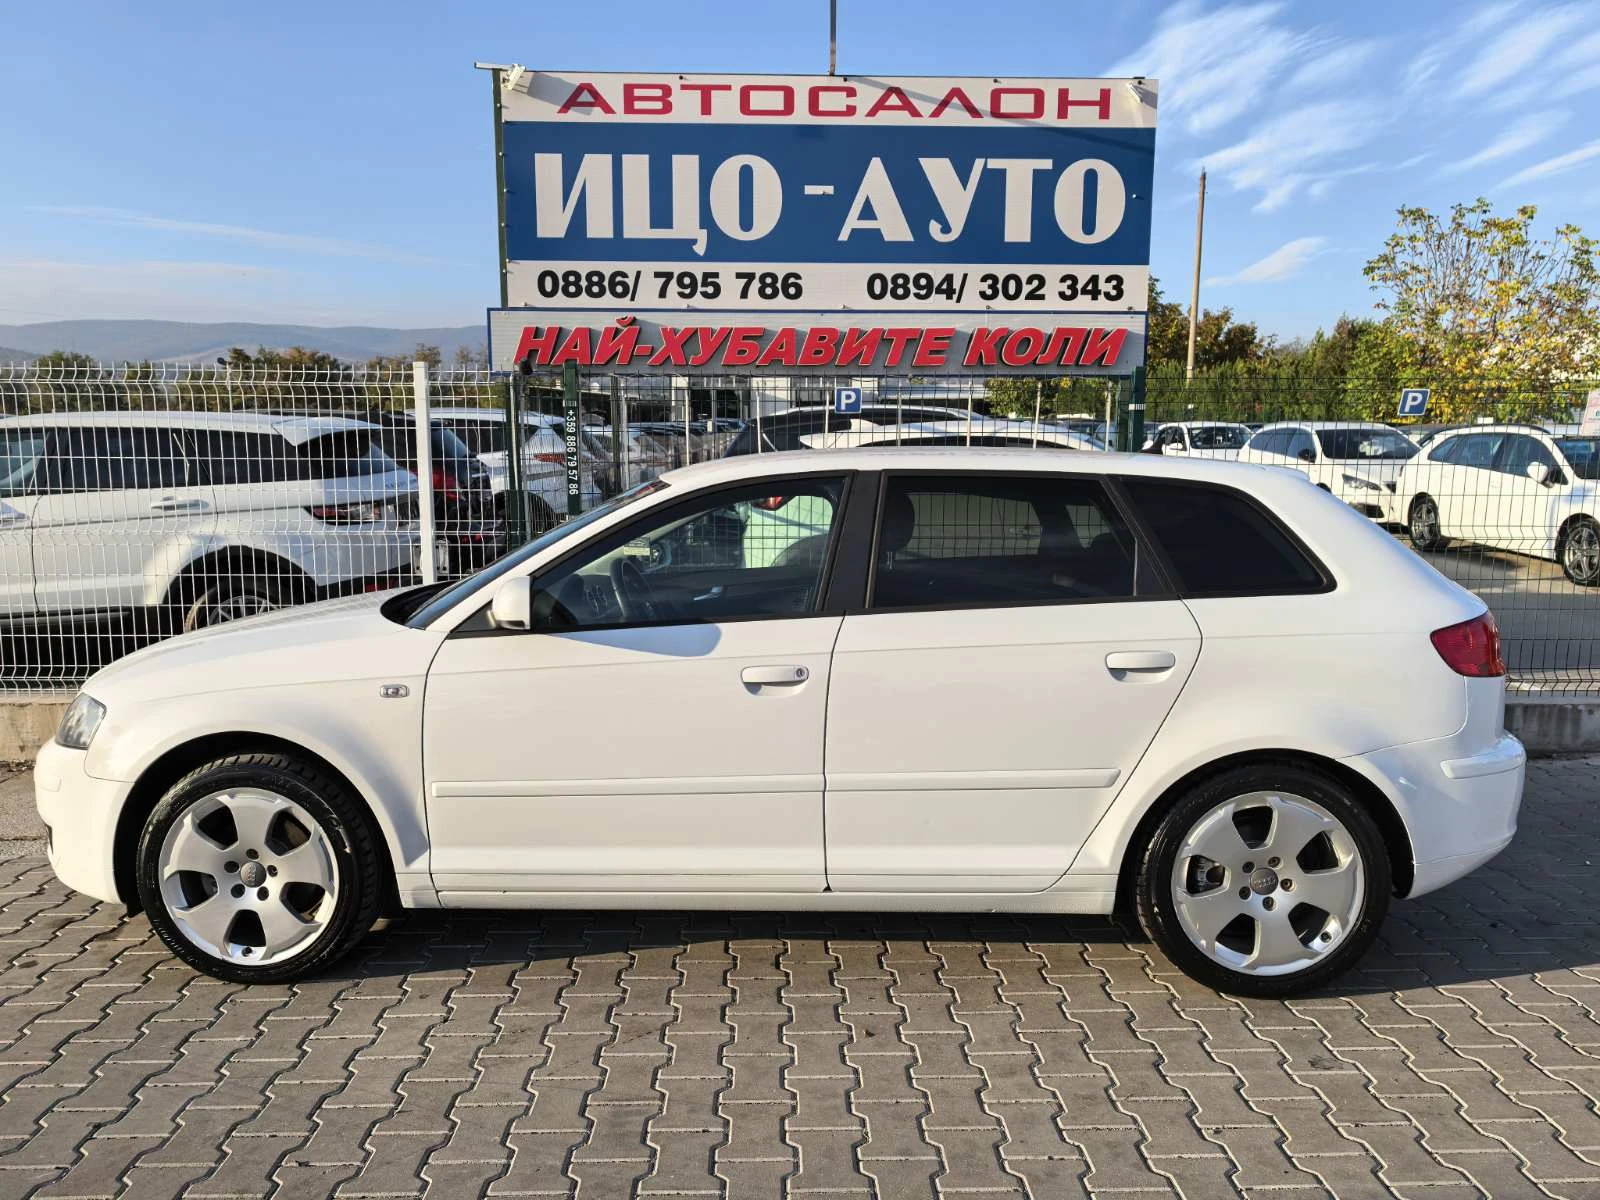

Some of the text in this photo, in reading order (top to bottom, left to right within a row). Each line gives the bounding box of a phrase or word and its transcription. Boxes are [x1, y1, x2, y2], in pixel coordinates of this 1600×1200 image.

[557, 82, 1112, 120] АВТОСАЛОН
[537, 269, 803, 302] 0886/ 795 786
[866, 272, 1125, 304] 0894/ 302 343
[512, 314, 1129, 367] НАЙ-ХУБАВИТЕ КОЛИ
[840, 390, 857, 411] P
[1404, 392, 1423, 412] P
[566, 409, 579, 495] +359 886 79 57 86
